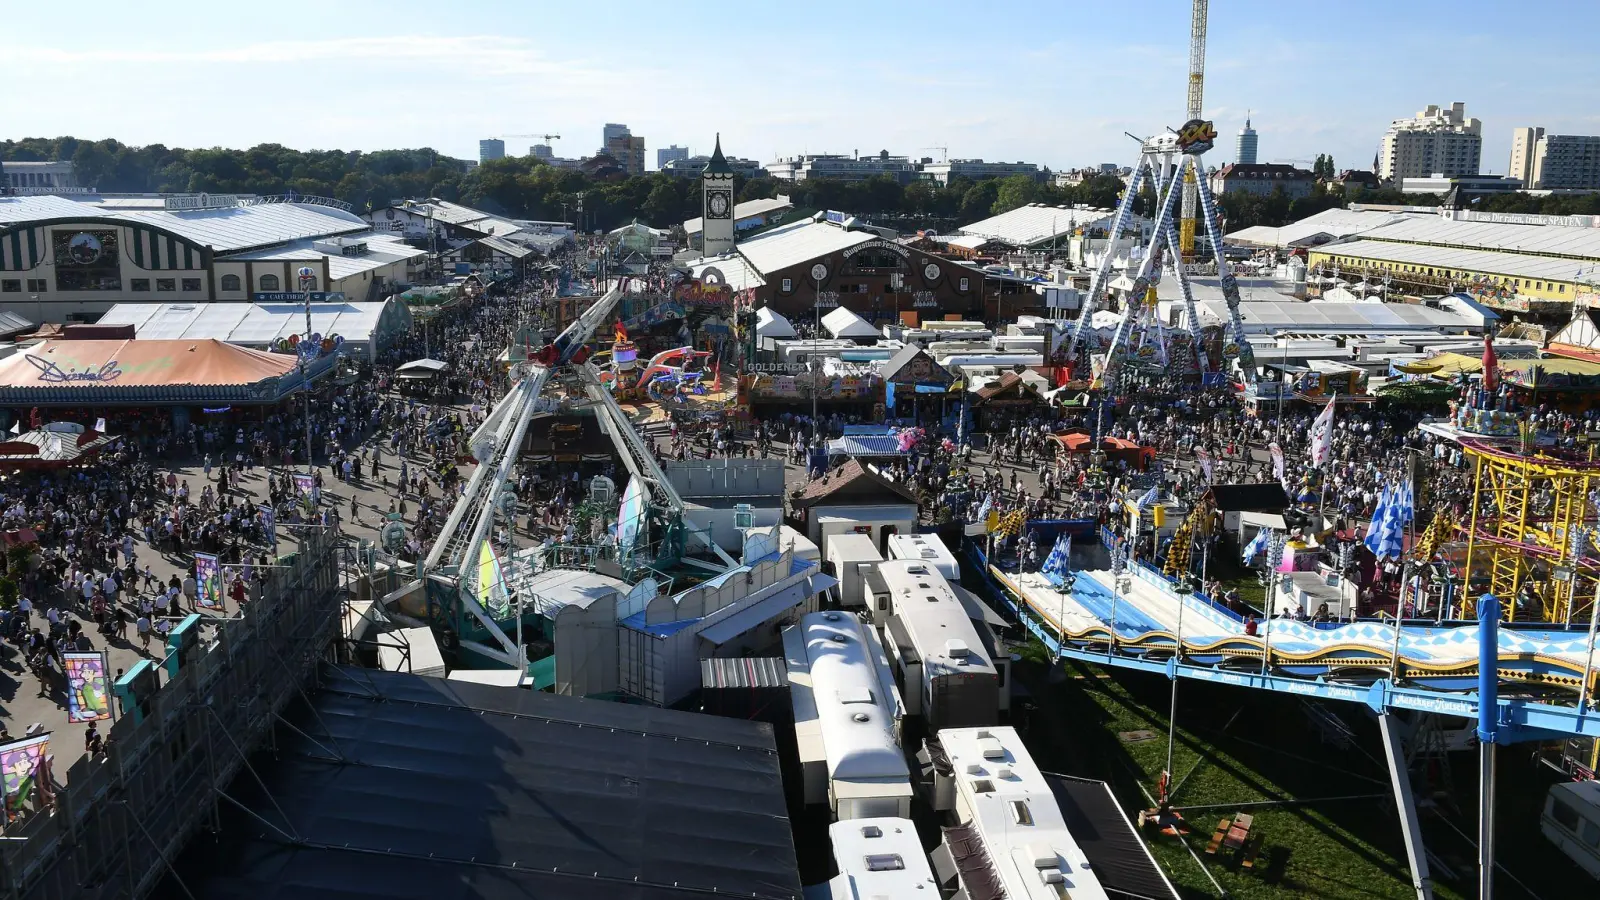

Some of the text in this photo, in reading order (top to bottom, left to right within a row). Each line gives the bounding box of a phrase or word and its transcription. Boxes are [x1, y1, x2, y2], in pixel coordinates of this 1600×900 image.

[1175, 121, 1217, 145] XXL
[169, 198, 198, 209] PSCHORR
[1491, 213, 1502, 221] Dir
[747, 363, 805, 371] GOLDENER
